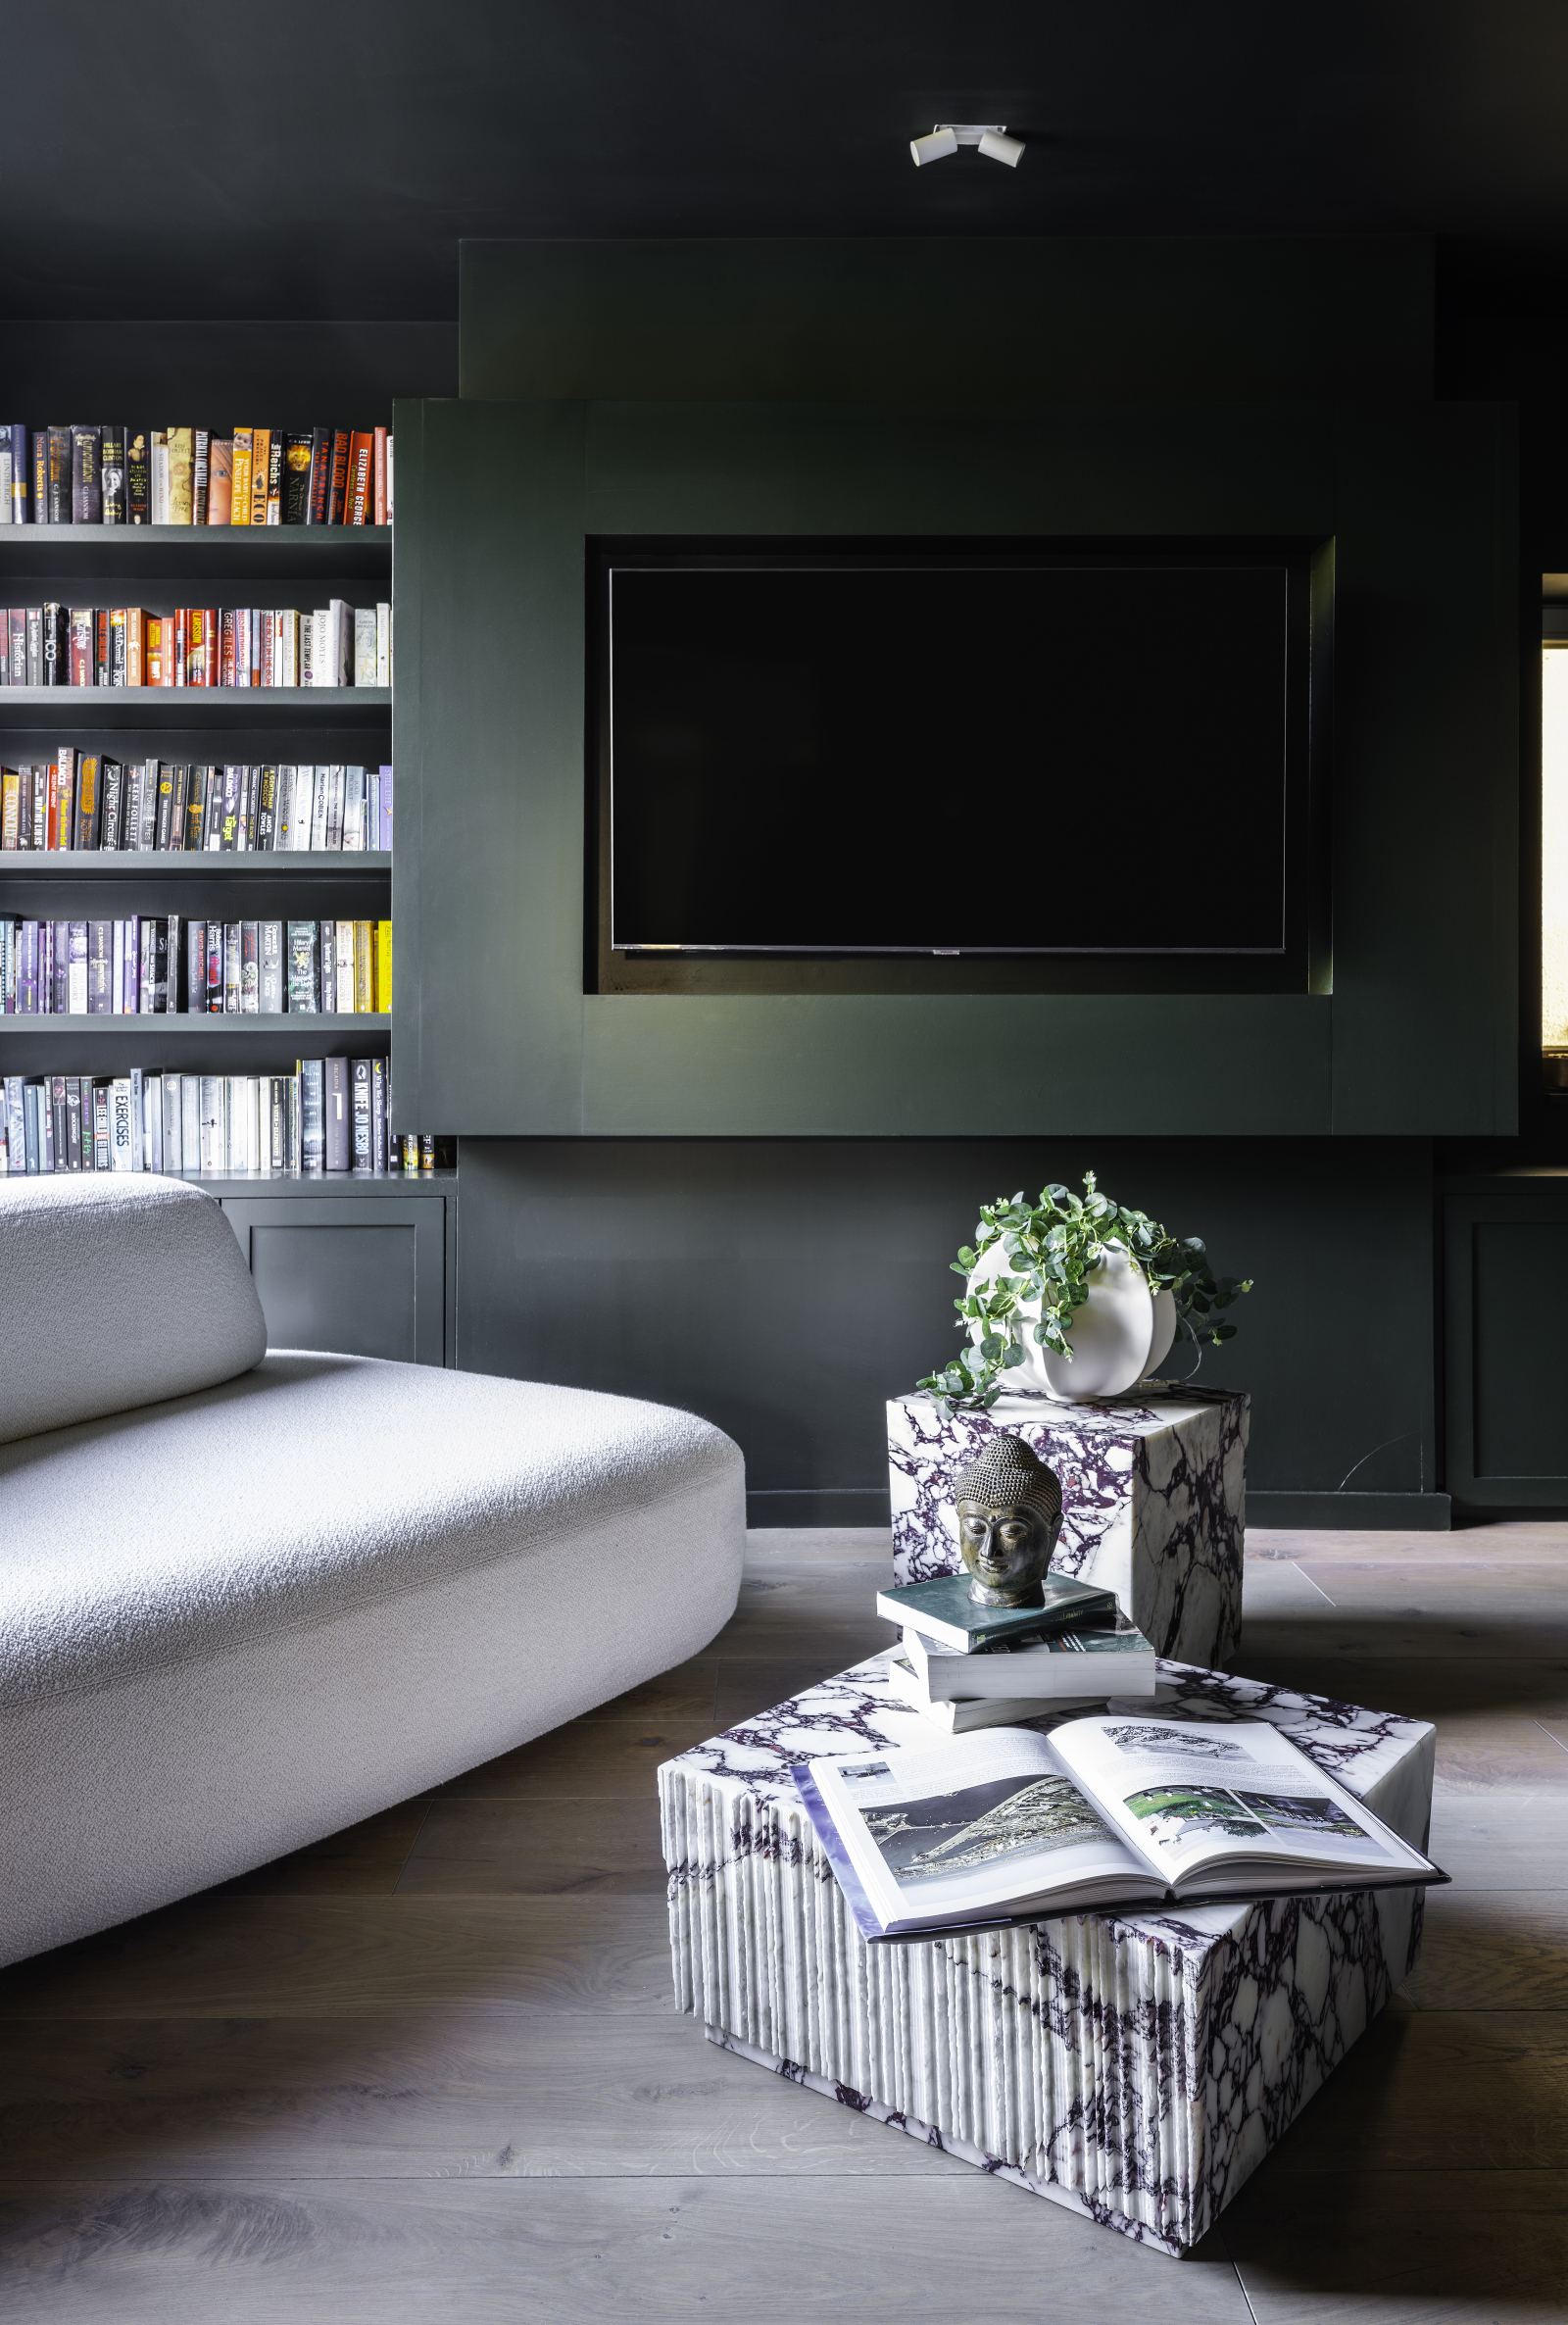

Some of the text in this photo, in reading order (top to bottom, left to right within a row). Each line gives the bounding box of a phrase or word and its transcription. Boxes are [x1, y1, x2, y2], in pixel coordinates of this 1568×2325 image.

[194, 431, 209, 488] PATRICIA CORNWELL
[270, 451, 282, 484] Reichs
[333, 433, 348, 488] BAD BLOOD
[349, 465, 358, 490] Careless
[233, 459, 244, 520] PENELOPE LEACH
[317, 442, 329, 519] TANA FRENCH
[354, 449, 368, 525] ELIZABETH GEORGE
[253, 494, 266, 523] ECO
[288, 477, 300, 522] NARNIA
[73, 613, 90, 650] Heartstone
[192, 613, 202, 644] LARSSON
[223, 613, 233, 656] GREG ILES
[13, 633, 24, 677] Historian
[45, 639, 57, 661] 100
[358, 653, 374, 686] 1421
[84, 763, 94, 809] ALLEGIANT
[5, 794, 18, 839] CONNOLLY
[107, 782, 119, 842] Night Circus
[129, 806, 138, 843] FOLLETT
[145, 818, 154, 841] ELITES
[223, 816, 235, 841] Target
[210, 957, 220, 985] Munich
[97, 1106, 108, 1115] LEE
[204, 1080, 214, 1117] volunteer
[376, 1089, 382, 1098] We
[97, 1116, 108, 1133] CHILD
[116, 1096, 129, 1147] EXERCISES
[355, 1082, 369, 1155] KNIFE JO NESBO
[98, 1148, 109, 1166] HOURS
